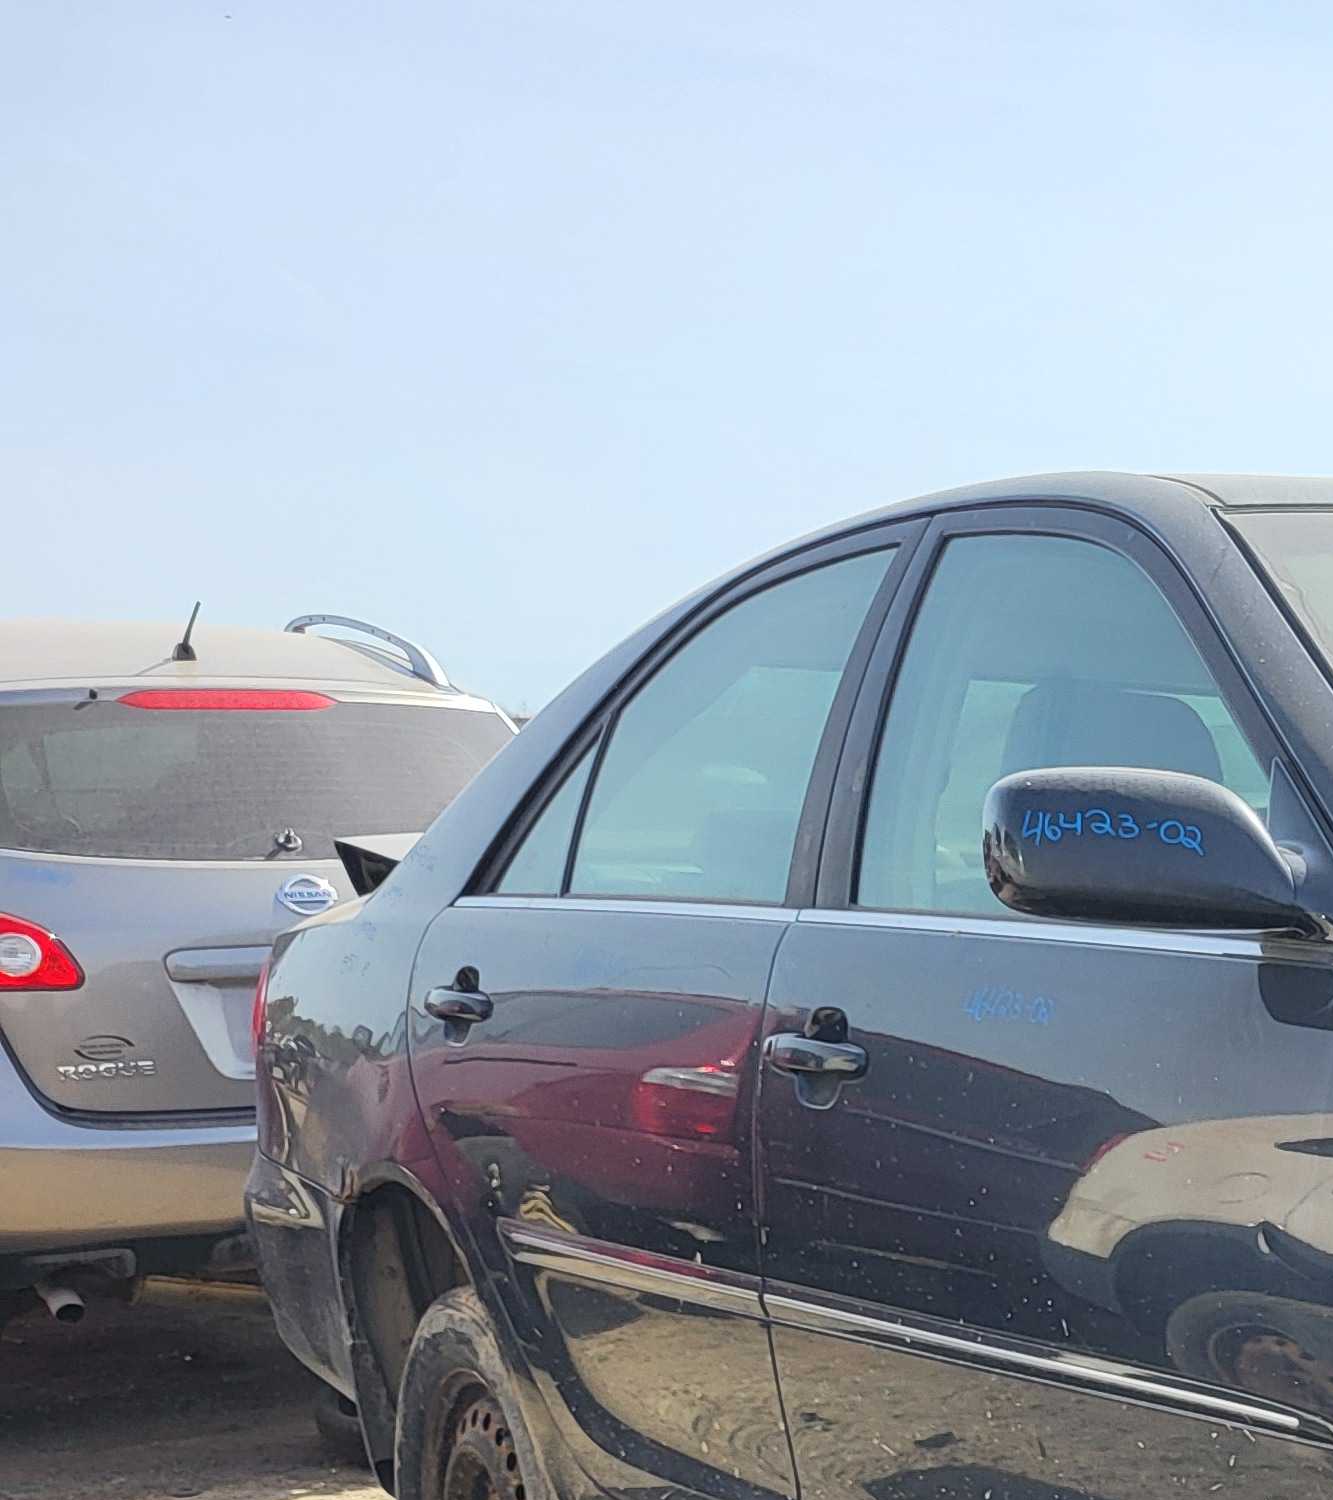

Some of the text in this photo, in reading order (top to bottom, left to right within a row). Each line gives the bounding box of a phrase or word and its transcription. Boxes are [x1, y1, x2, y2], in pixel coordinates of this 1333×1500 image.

[1021, 808, 1205, 857] 46423-02
[283, 888, 331, 898] NISSAN
[56, 1060, 156, 1080] ROGUE
